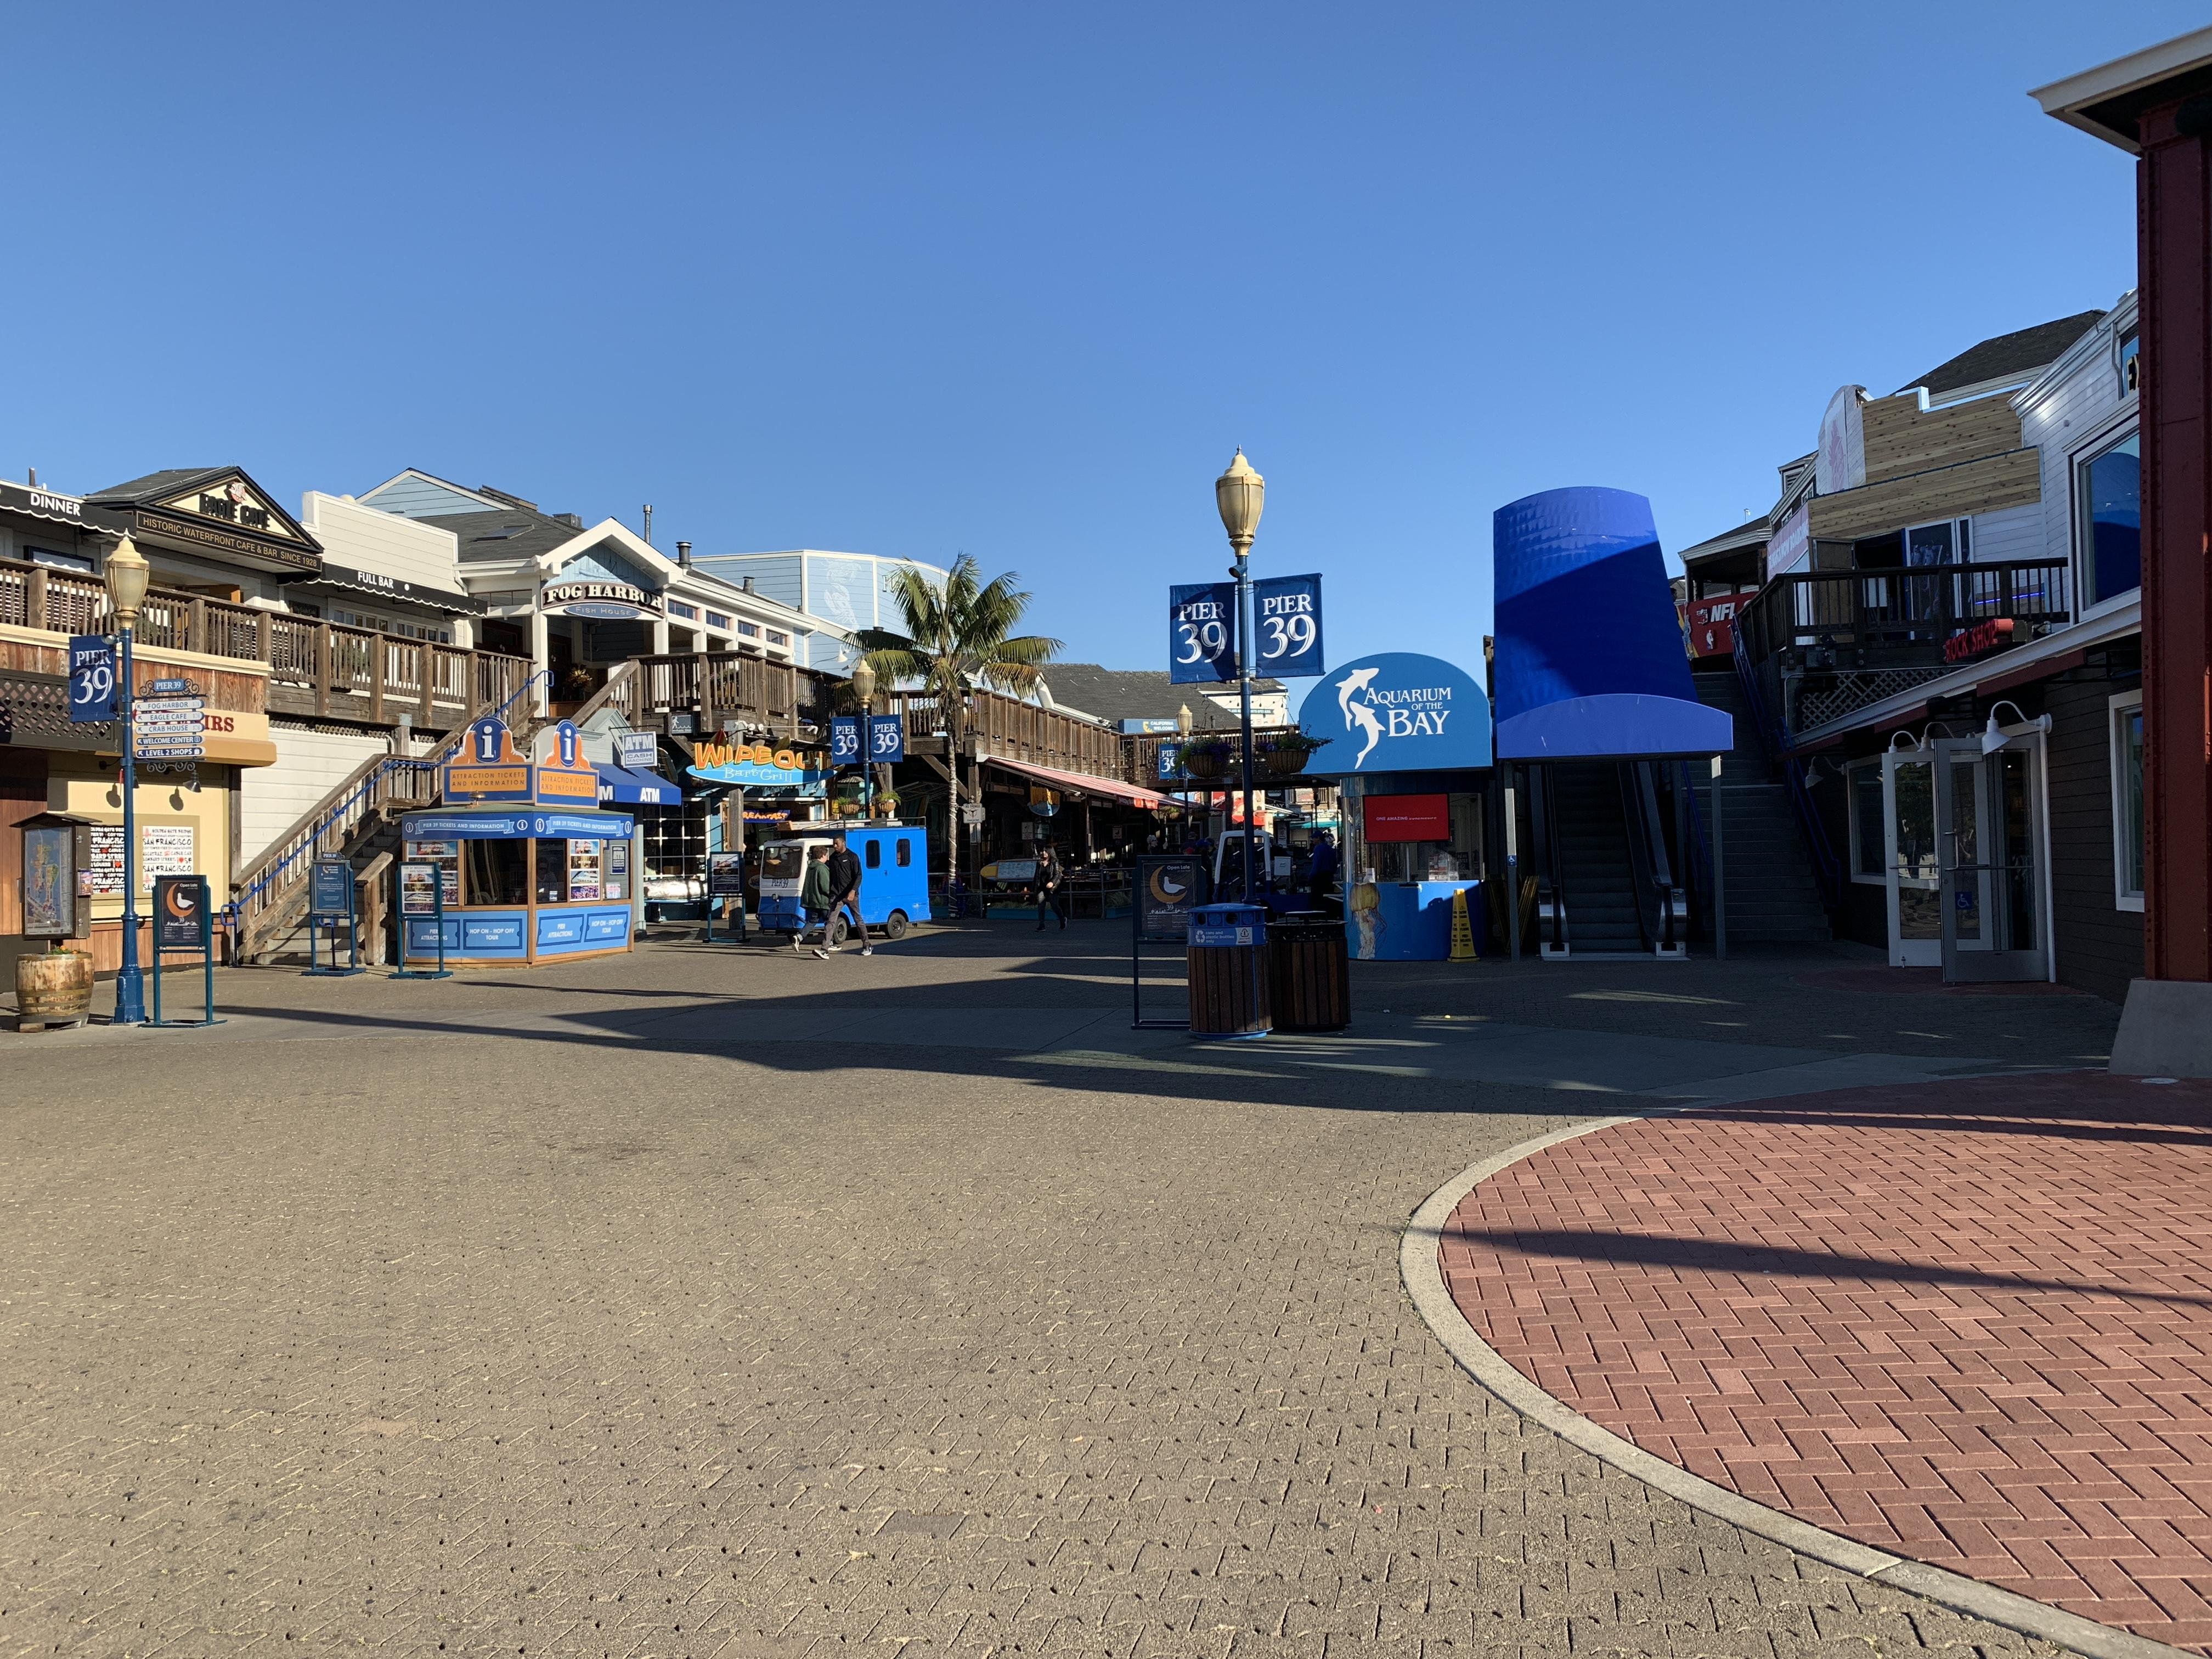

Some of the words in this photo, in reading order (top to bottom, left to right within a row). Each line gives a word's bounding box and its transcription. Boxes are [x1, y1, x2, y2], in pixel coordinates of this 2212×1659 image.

[31, 493, 81, 517] DINNER
[199, 493, 237, 521] EAGLE
[143, 517, 183, 534] HISTORIC
[183, 527, 235, 547] WATERFRONT
[236, 540, 256, 552] CAFE
[257, 545, 262, 553] &
[263, 546, 278, 557] BAR
[280, 551, 301, 562] SINCE
[302, 556, 317, 567] 1928
[358, 571, 377, 585] FULL
[379, 577, 394, 589] BAR
[546, 585, 583, 602] FOG
[587, 585, 663, 610] HARBOR
[1262, 594, 1313, 616] PIER
[601, 607, 631, 615] HOUSE
[1178, 602, 1226, 621] PIER
[1711, 602, 1735, 623] NFL
[1177, 621, 1227, 664] 39
[1262, 614, 1316, 658] 39
[75, 649, 111, 666] PIER
[75, 666, 112, 704] 39
[1363, 687, 1452, 708] AQUARIUM
[836, 725, 857, 735] PIER
[874, 723, 897, 733] PIER
[1387, 709, 1451, 737] BAY
[625, 735, 653, 751] ATM
[835, 735, 859, 755] 39
[873, 732, 899, 753] 39
[695, 742, 832, 771] WIPEOUT
[760, 768, 792, 782] Grill
[555, 785, 595, 793] INFORMATION
[640, 787, 660, 802] ATM
[742, 811, 788, 820] REAKFAST
[771, 878, 782, 887] PIER
[782, 878, 789, 888] 39
